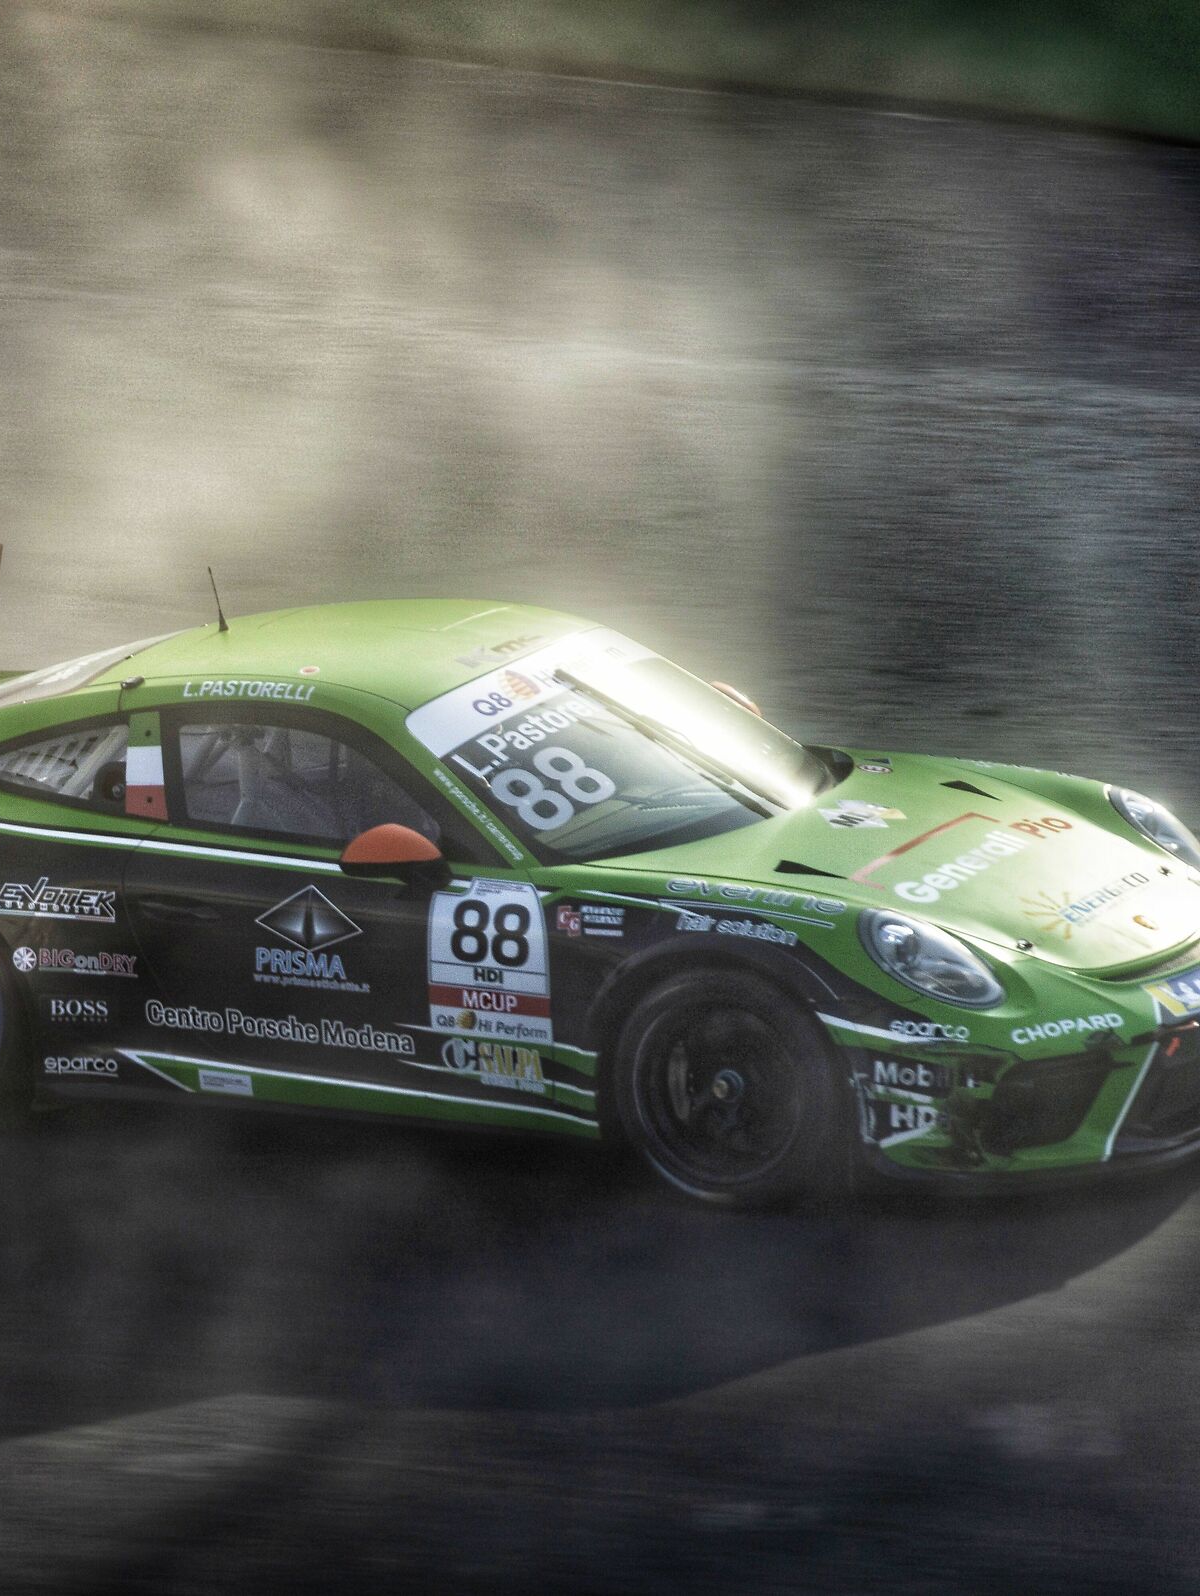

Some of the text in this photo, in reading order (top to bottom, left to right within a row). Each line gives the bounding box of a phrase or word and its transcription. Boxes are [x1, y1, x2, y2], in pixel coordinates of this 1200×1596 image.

[183, 680, 316, 701] L.PASTORELLI
[472, 691, 513, 717] Q8
[490, 746, 616, 830] 88
[894, 830, 1029, 903] Generali
[451, 899, 531, 968] 88
[255, 946, 347, 980] PRISMA
[473, 968, 504, 984] HDI
[51, 998, 108, 1017] BOSS
[462, 989, 518, 1012] MCUP
[146, 999, 416, 1055] Centro Porsche Modena
[436, 1013, 548, 1040] Q8 Hi Perform
[1011, 1012, 1125, 1045] CHOPARD
[44, 1055, 118, 1075] sparco
